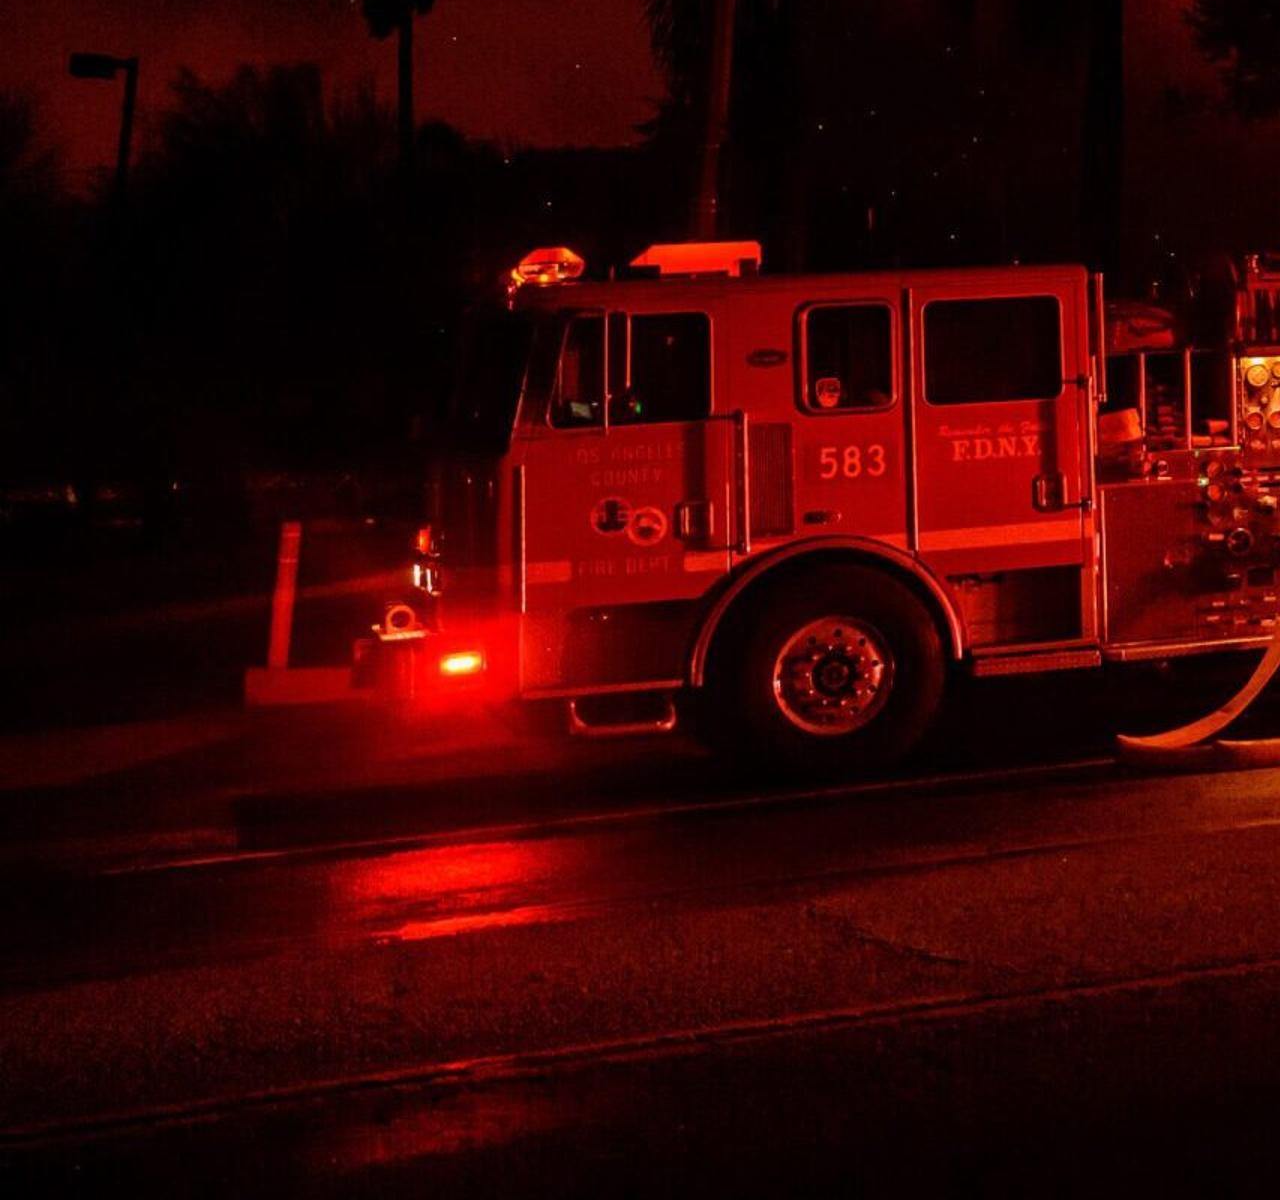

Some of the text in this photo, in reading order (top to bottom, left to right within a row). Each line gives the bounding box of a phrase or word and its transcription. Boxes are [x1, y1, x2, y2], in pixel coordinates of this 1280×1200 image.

[818, 443, 887, 479] 583
[590, 468, 664, 487] COUNTY
[577, 559, 617, 576] FIRE
